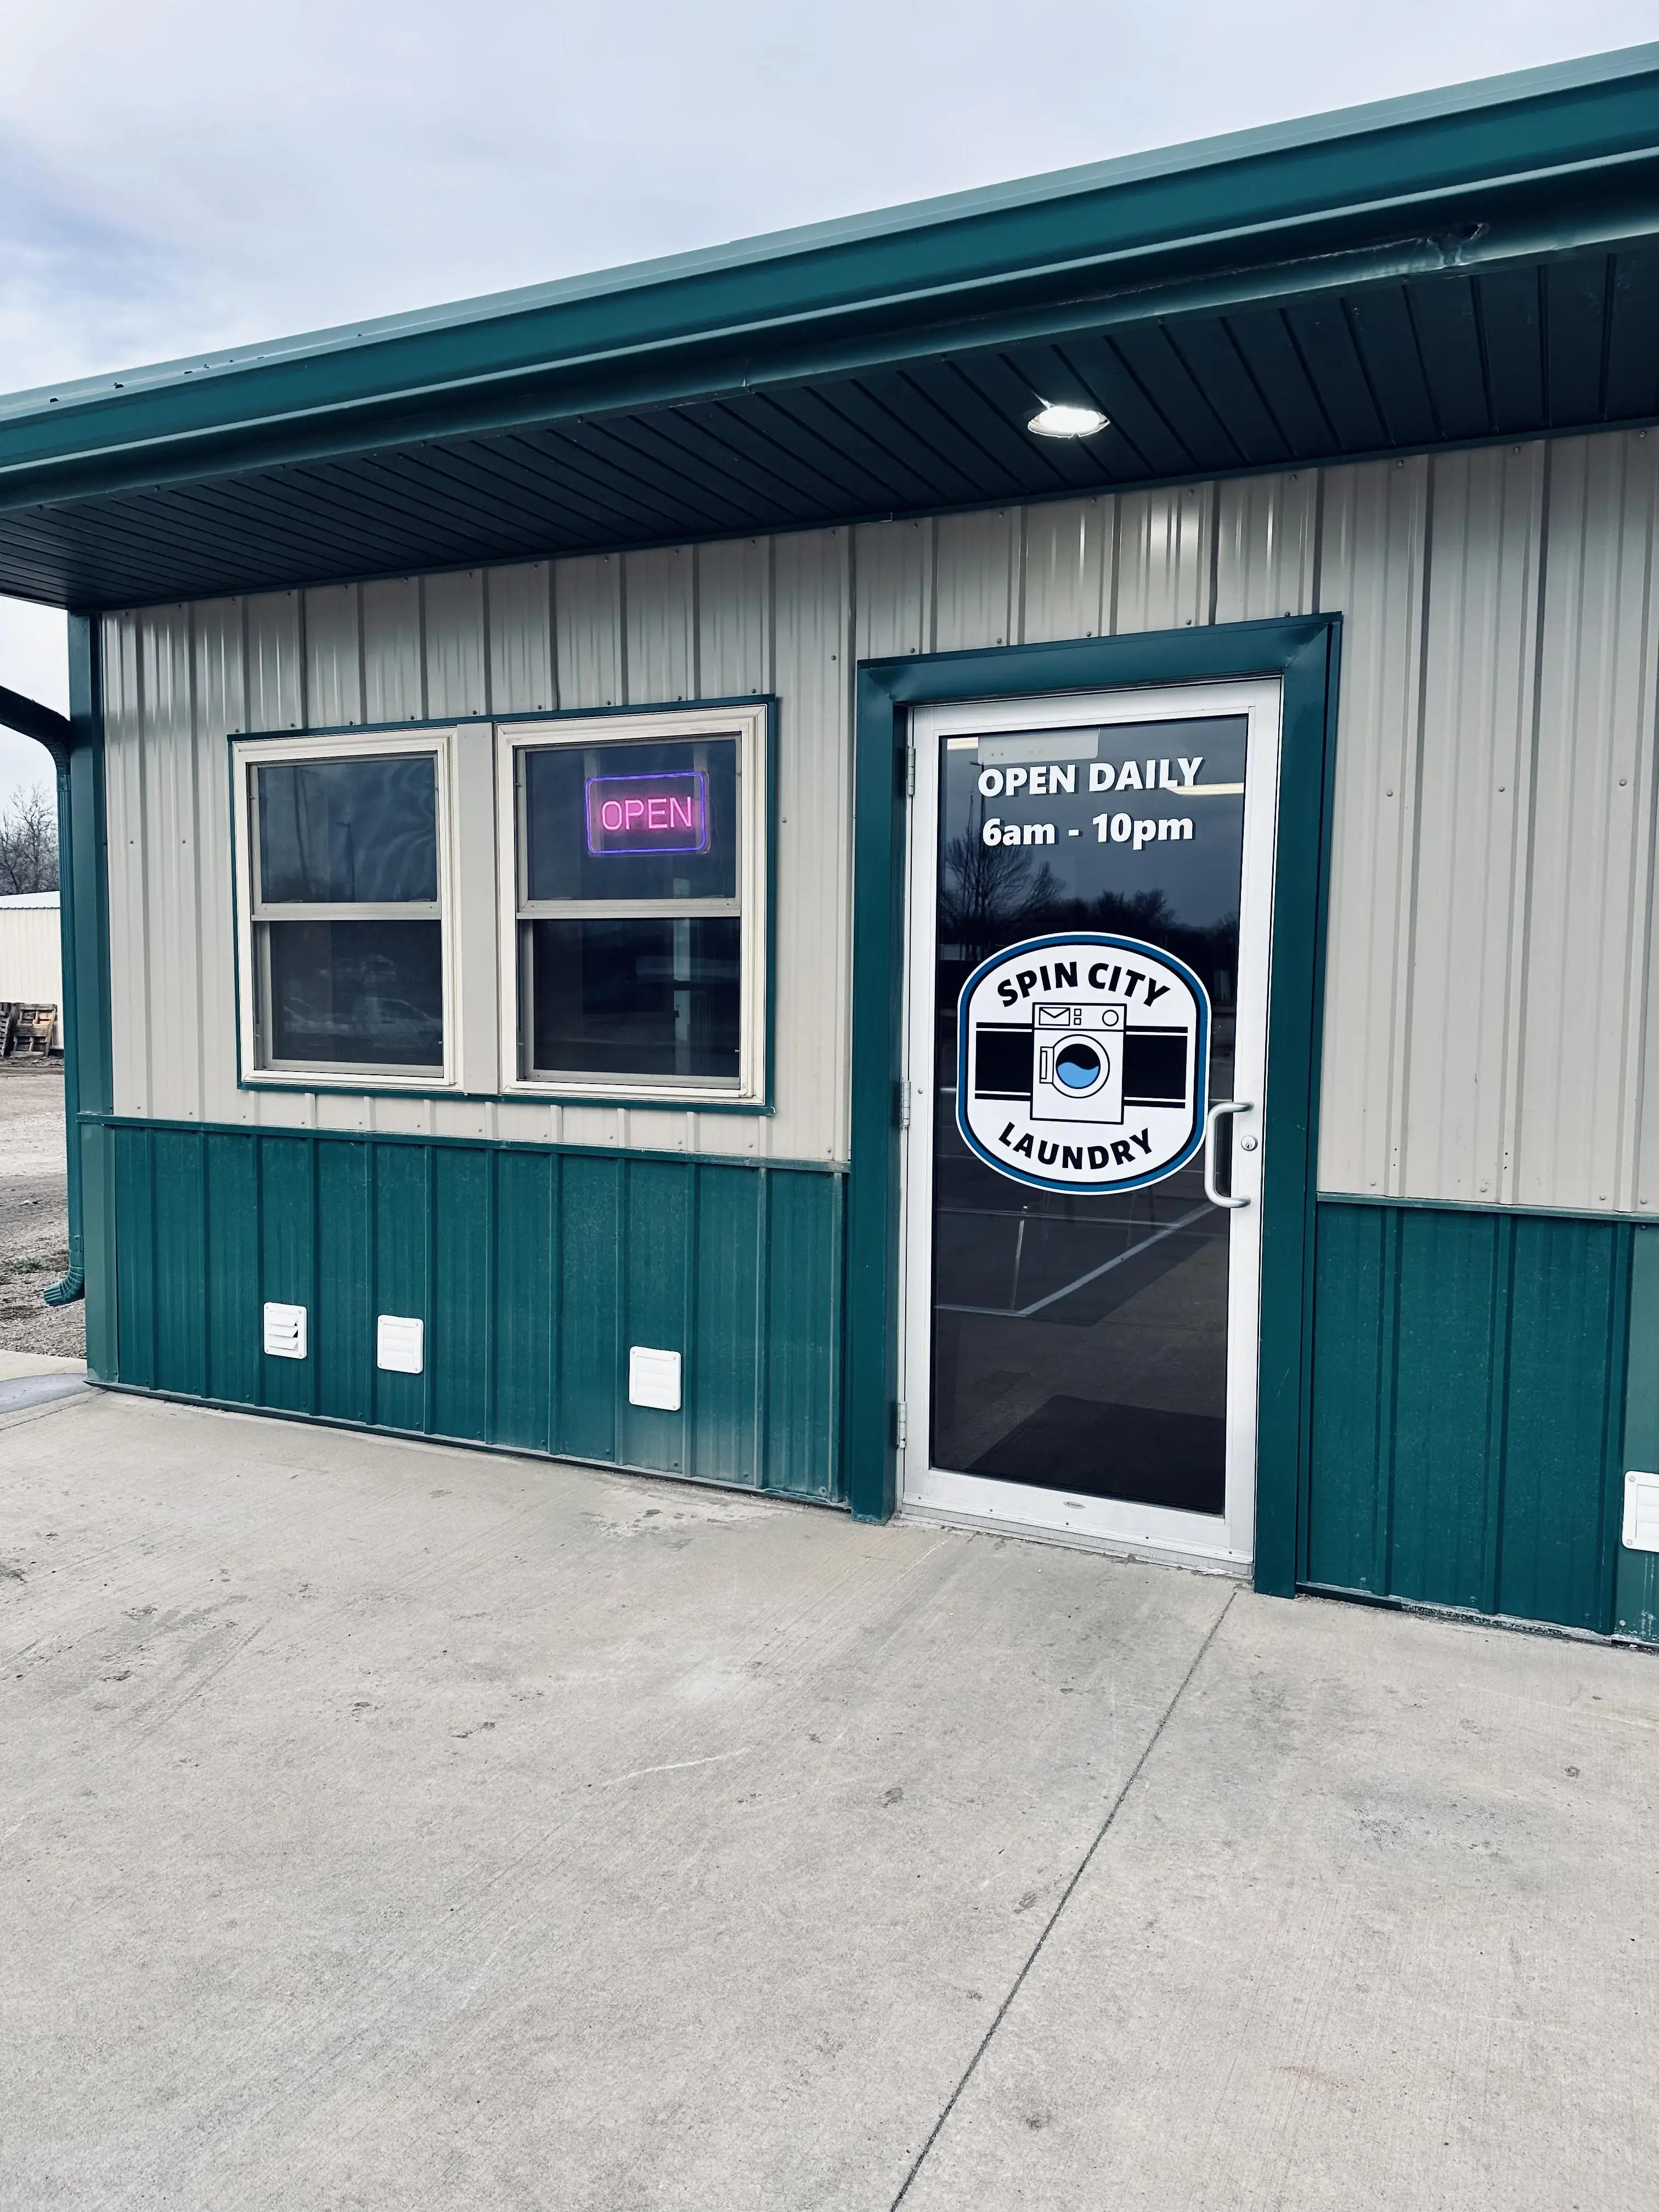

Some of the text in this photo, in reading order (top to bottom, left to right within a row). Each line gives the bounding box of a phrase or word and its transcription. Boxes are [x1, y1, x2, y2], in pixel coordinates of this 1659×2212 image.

[978, 757, 1204, 797] OPEN DAILY
[601, 796, 692, 831] OPEN
[983, 818, 1055, 846] 6am
[1092, 812, 1193, 850] 10pm
[997, 961, 1171, 1007] SPIN CITY
[998, 1121, 1152, 1170] LAUNDRY
